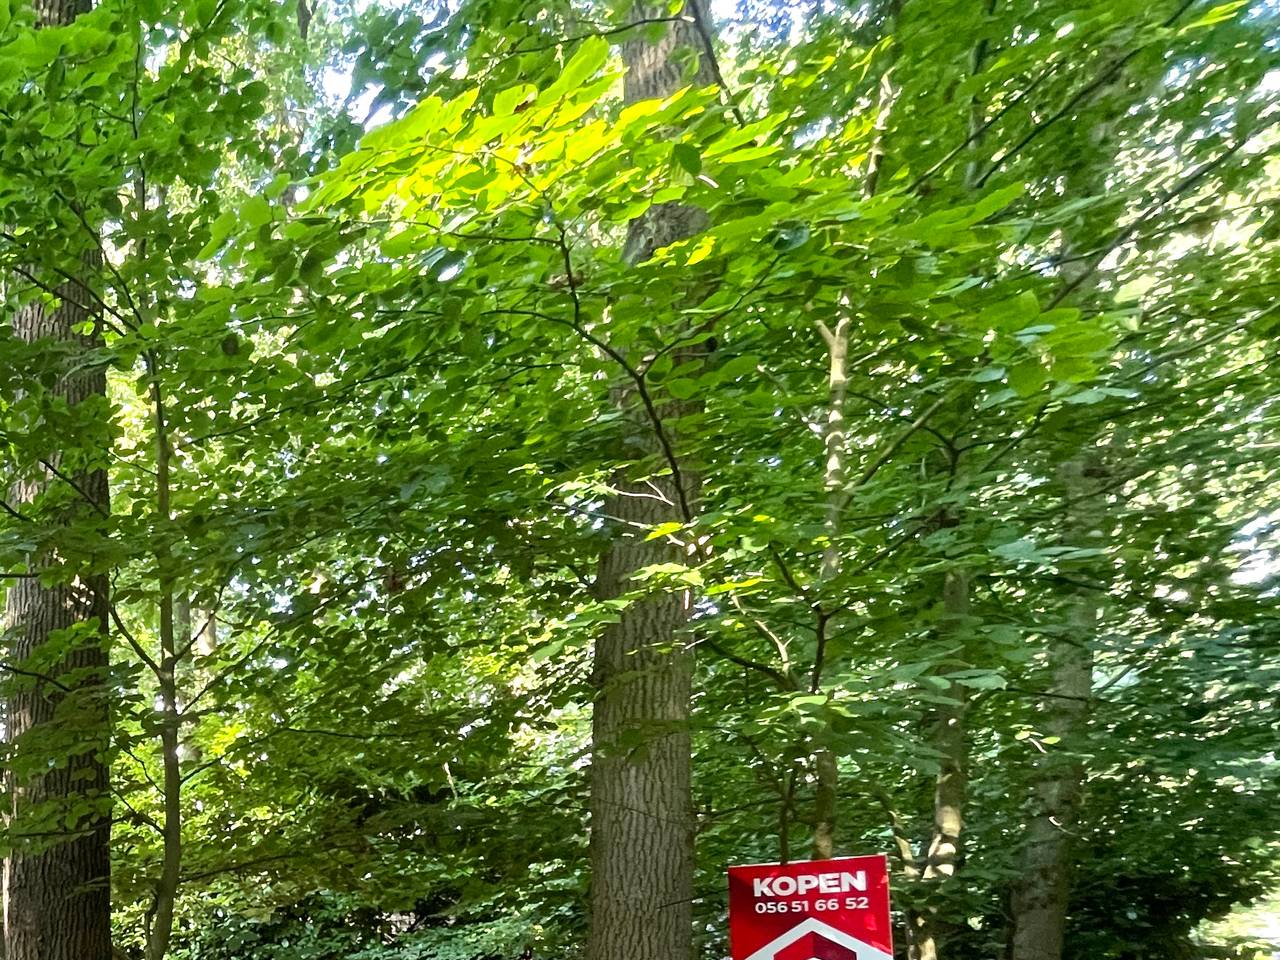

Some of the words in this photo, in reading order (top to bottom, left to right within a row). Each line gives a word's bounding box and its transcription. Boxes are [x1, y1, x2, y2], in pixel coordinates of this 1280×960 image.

[753, 870, 867, 897] KOPEN
[755, 901, 788, 914] 056
[791, 900, 809, 912] 51
[814, 898, 839, 911] 66
[845, 897, 869, 910] 52
